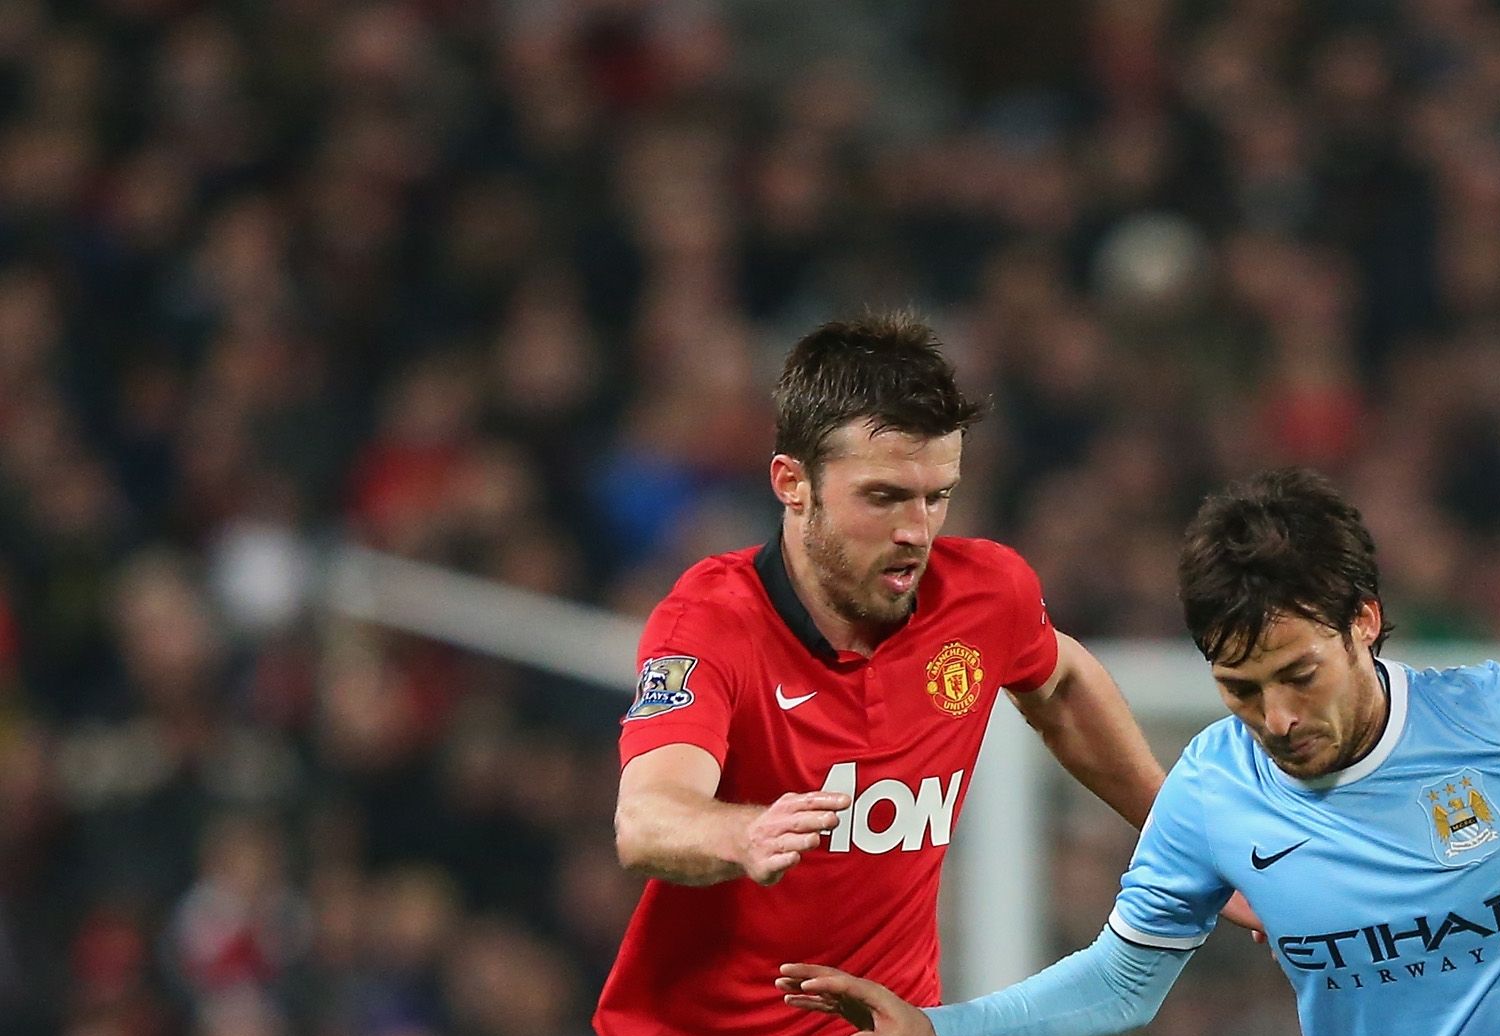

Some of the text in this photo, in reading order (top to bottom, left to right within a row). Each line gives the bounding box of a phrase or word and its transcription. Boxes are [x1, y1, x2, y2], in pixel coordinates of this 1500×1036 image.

[931, 648, 977, 675] MANCHESTER
[943, 694, 975, 710] UNITED
[820, 761, 964, 854] AON
